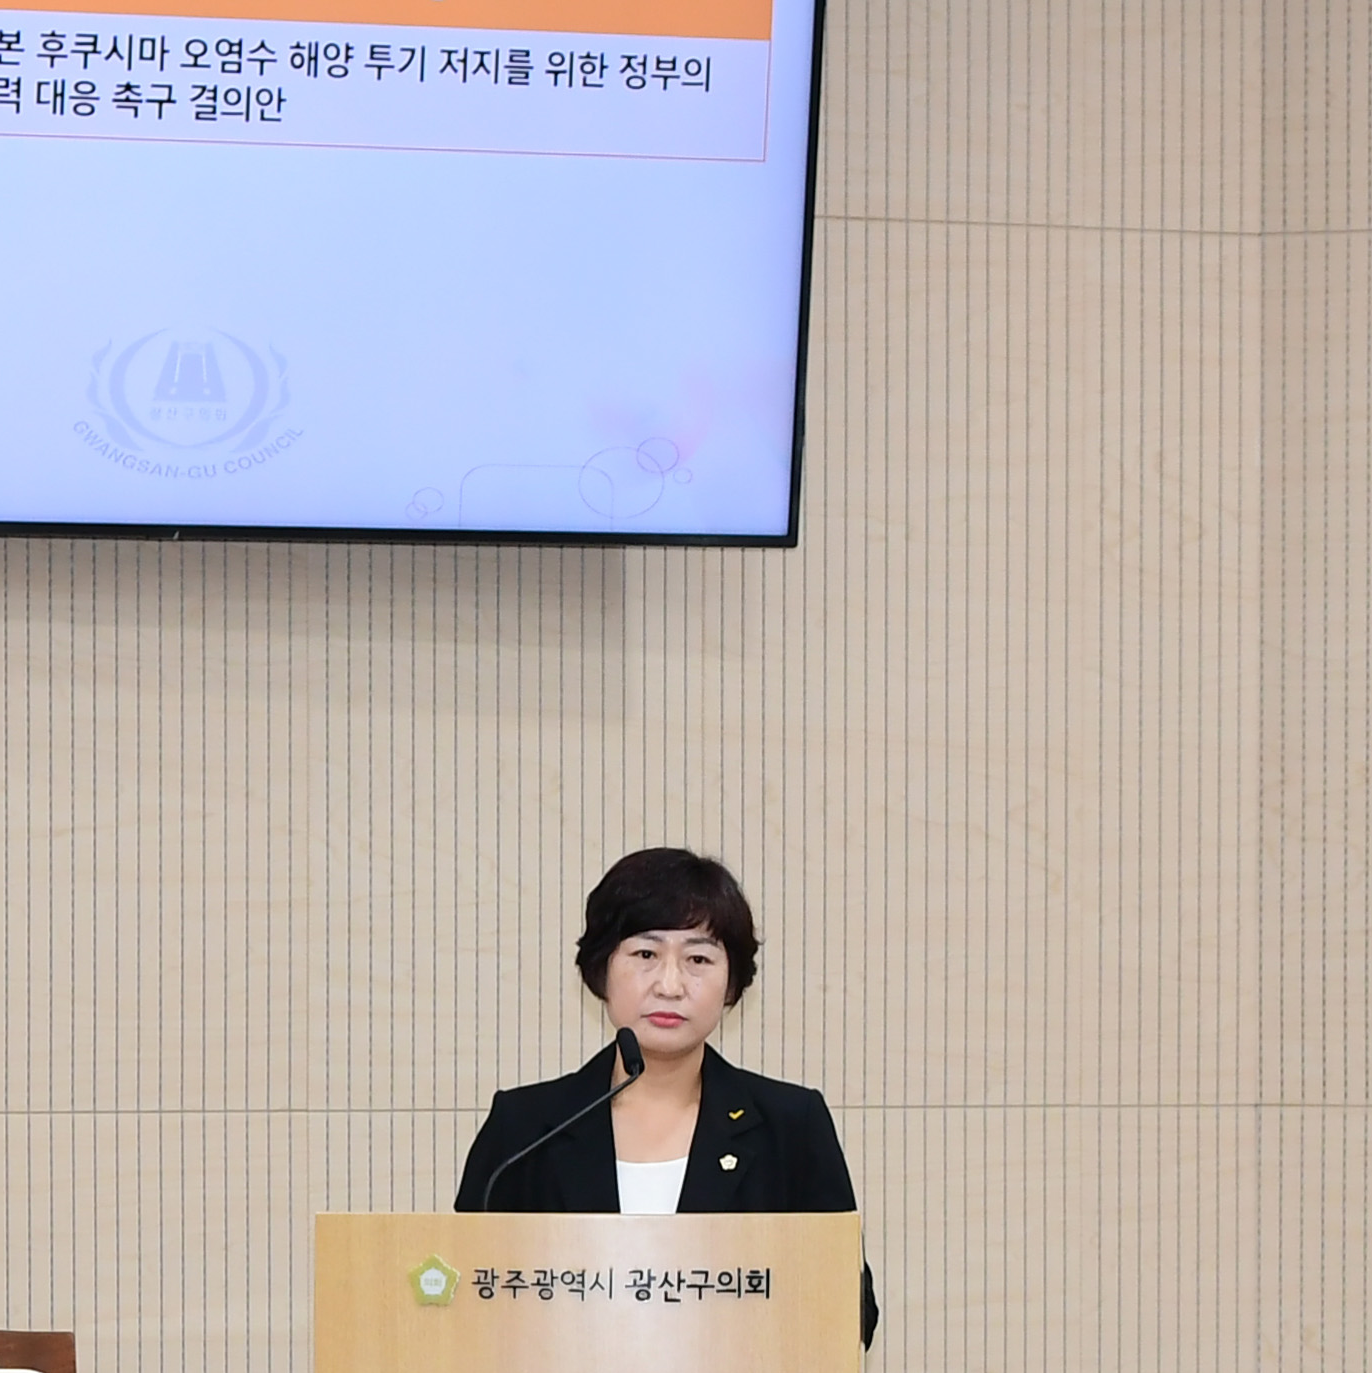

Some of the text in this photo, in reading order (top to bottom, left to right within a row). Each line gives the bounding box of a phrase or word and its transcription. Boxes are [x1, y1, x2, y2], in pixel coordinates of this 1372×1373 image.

[36, 30, 170, 72] 후쿠시마
[180, 38, 278, 76] 오염수
[289, 41, 354, 79] 해양
[364, 44, 426, 83] 투기
[439, 47, 534, 86] 저지를
[545, 51, 609, 88] 위한
[619, 54, 711, 93] 정부의
[36, 79, 100, 117] 대응
[112, 81, 177, 120] 촉구
[190, 84, 287, 123] 결의안
[73, 419, 304, 479] GWANGSAN-GU COUNCIL
[471, 1267, 771, 1303] 광주광역시 광산구의회
